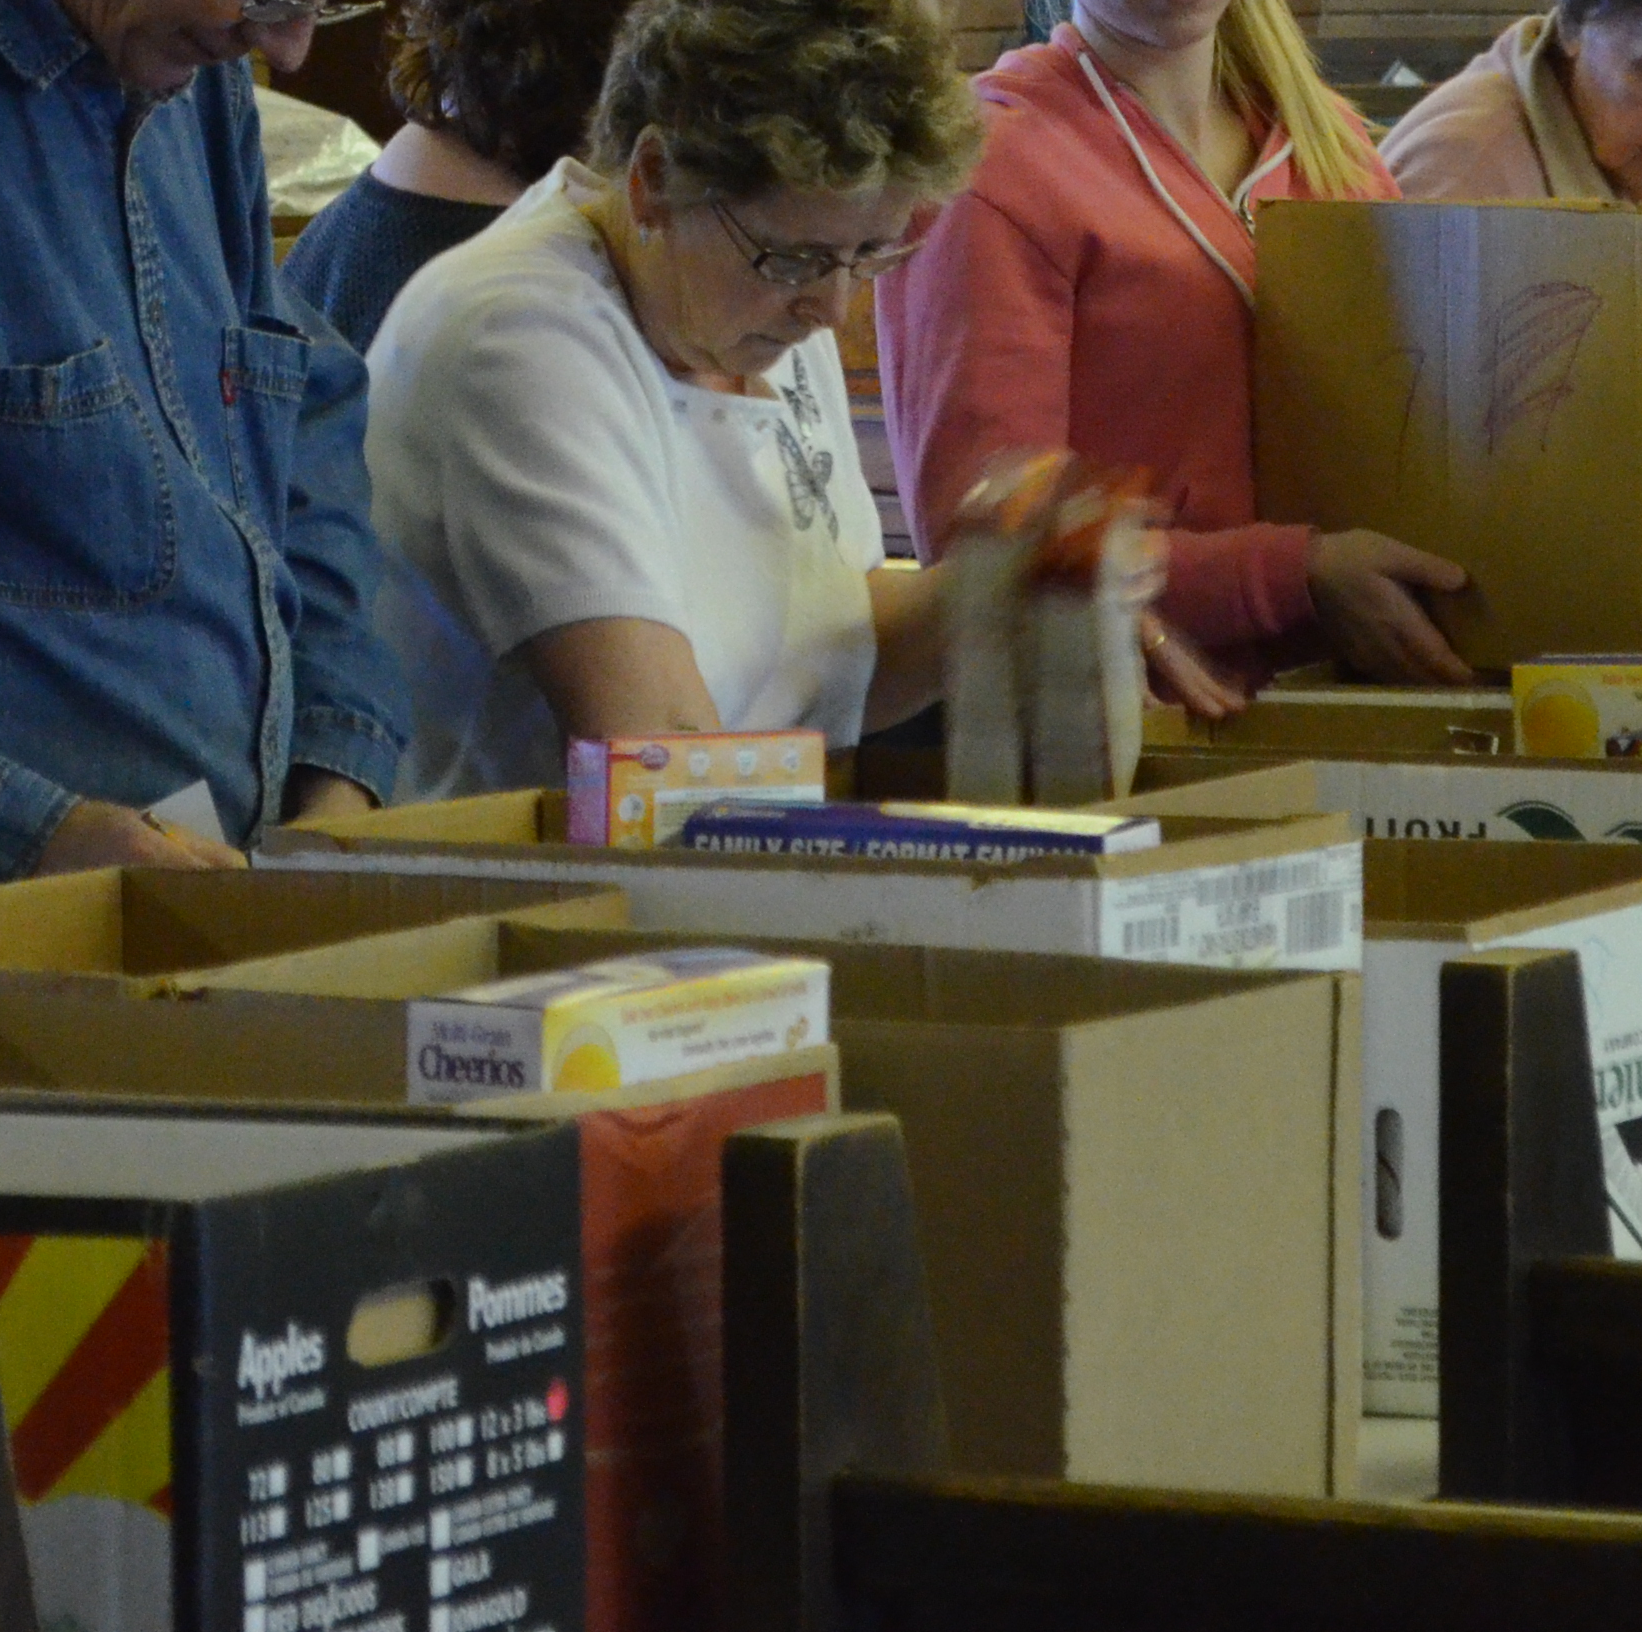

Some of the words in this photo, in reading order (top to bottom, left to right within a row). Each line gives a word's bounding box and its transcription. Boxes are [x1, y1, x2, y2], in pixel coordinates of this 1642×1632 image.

[417, 1044, 526, 1089] Cheerios
[467, 1271, 568, 1334] Pommes
[237, 1319, 325, 1397] Apples
